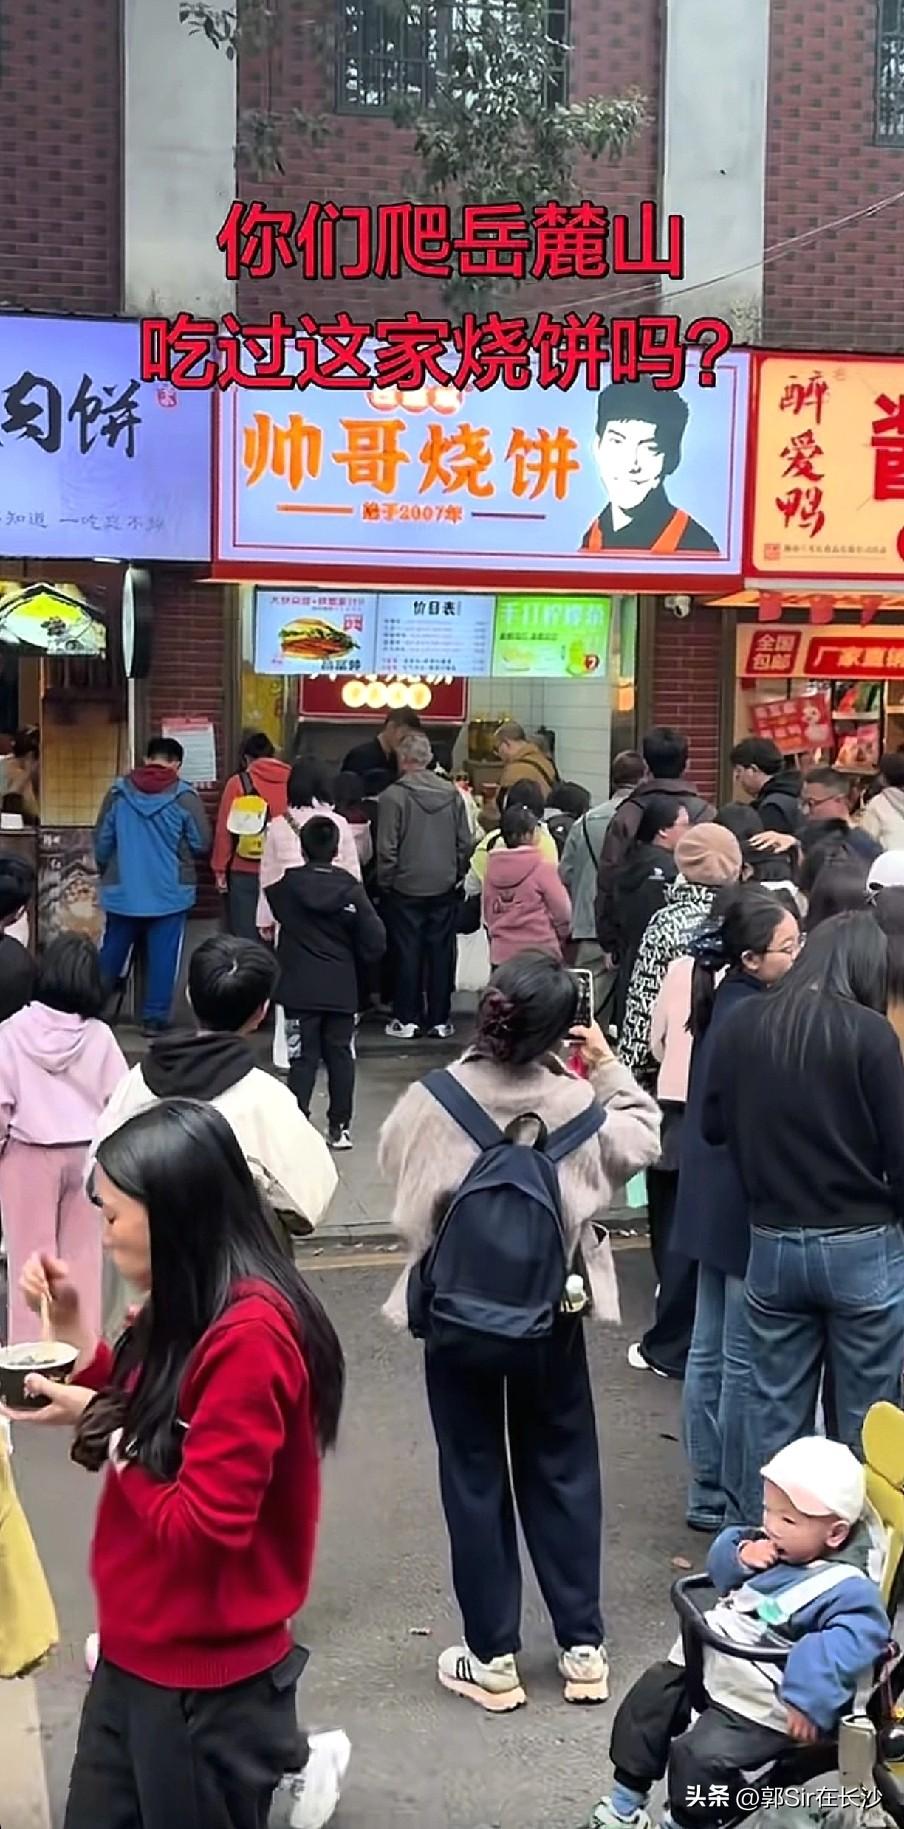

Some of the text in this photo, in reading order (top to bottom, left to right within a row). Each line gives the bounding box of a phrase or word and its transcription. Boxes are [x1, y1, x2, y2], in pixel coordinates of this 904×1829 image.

[242, 414, 580, 501] 帅哥烧饼
[775, 370, 829, 538] 醉爱鸭
[757, 634, 796, 651] 全国
